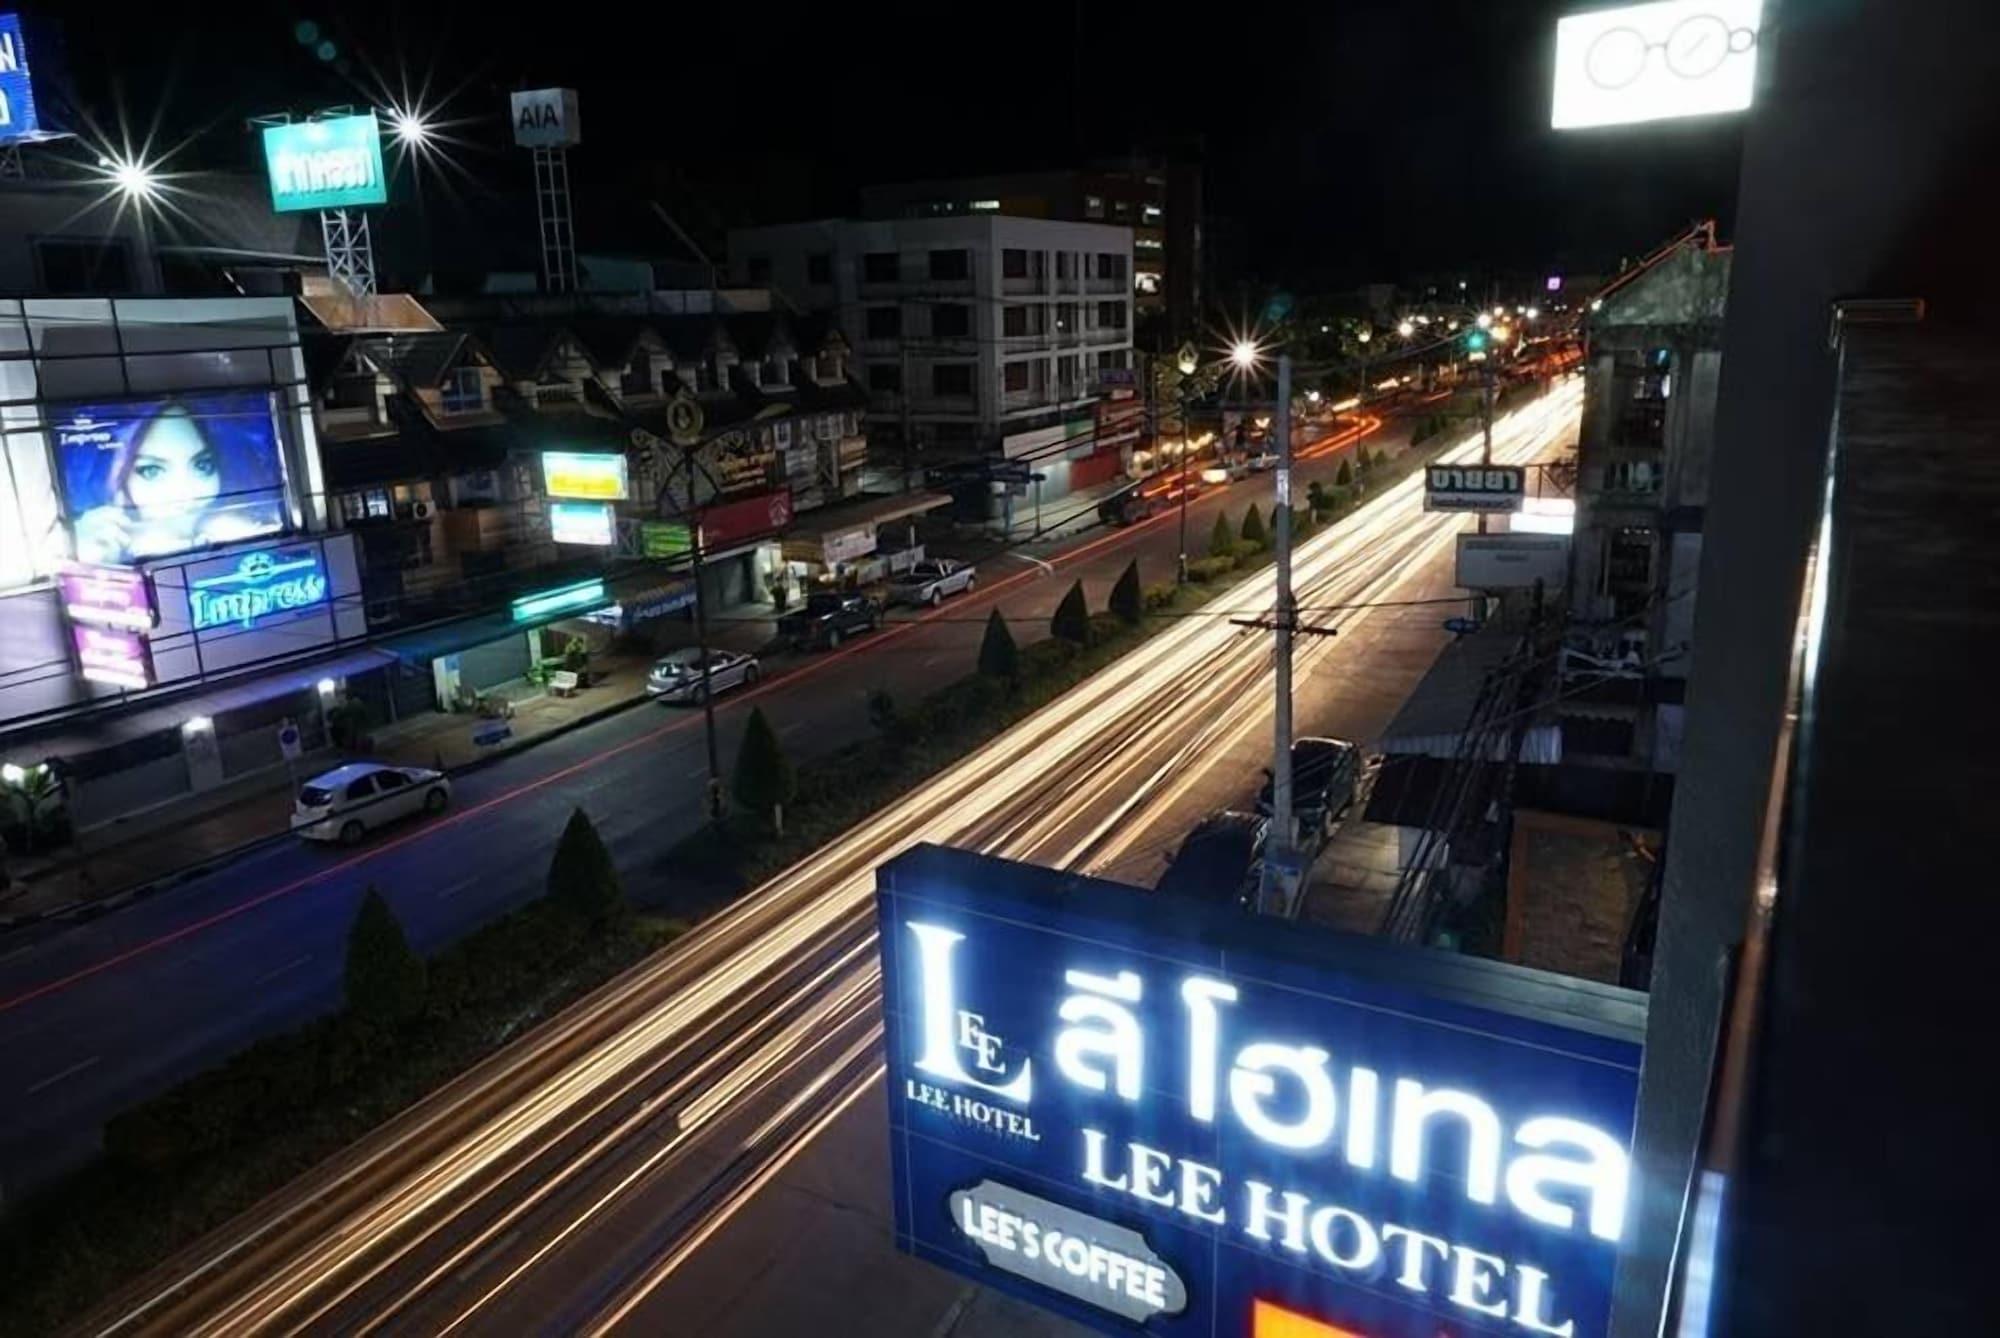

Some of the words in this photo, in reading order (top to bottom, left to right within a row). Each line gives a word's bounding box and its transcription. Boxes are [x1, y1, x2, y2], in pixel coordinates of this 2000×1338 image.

[519, 103, 559, 129] AIA
[190, 574, 326, 630] Impress
[906, 1080, 950, 1111] LEE
[953, 1095, 1040, 1141] HOTEL
[1054, 969, 1144, 1101] ลี
[1181, 976, 1632, 1242] โฮเทล
[963, 1198, 1040, 1259] LEE'S
[1043, 1231, 1166, 1309] COFFEE
[1082, 1128, 1226, 1225] LEE
[1244, 1180, 1574, 1338] HOTEL
